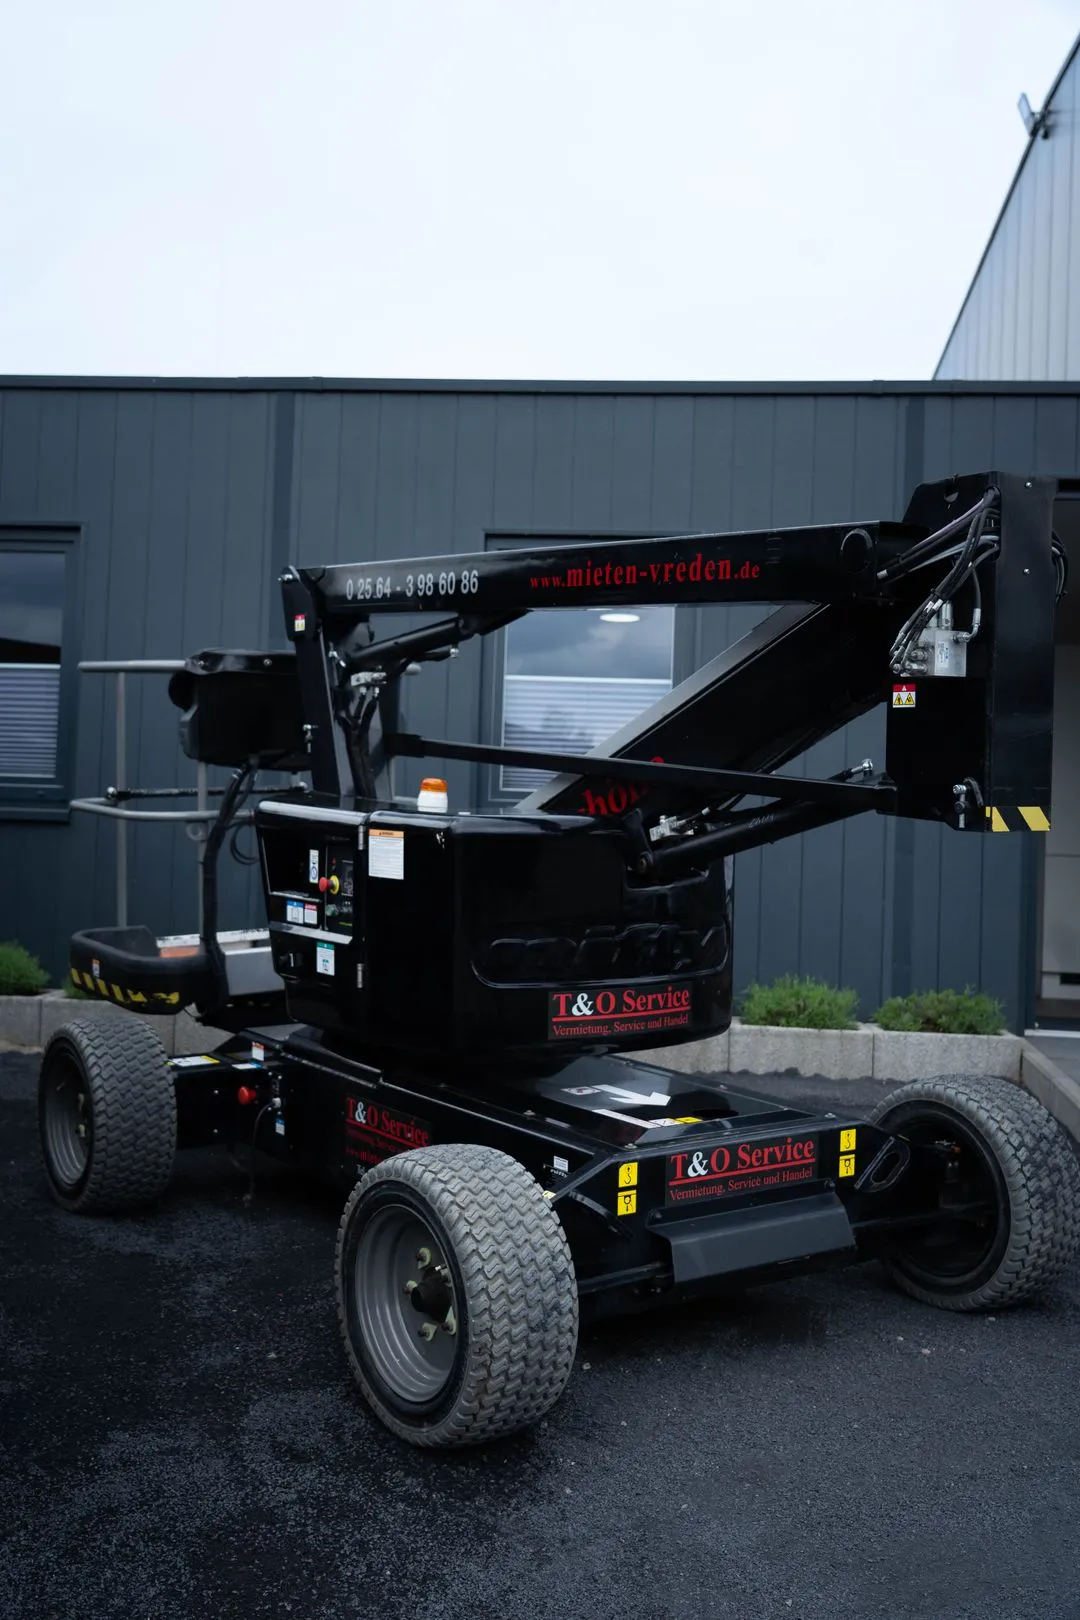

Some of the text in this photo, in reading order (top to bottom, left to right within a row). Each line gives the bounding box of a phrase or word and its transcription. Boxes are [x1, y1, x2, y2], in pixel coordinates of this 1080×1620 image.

[405, 574, 414, 598] 3
[417, 573, 434, 597] 98
[438, 571, 456, 596] 60
[460, 569, 479, 594] 86
[529, 552, 760, 589] www.mieten-vreden.de
[552, 985, 691, 1017] T&O Service
[552, 1013, 689, 1037] Vermietung, Service und Handel
[345, 1096, 379, 1128] T&O
[381, 1107, 430, 1146] Service
[670, 1137, 815, 1180] T&O Service
[669, 1166, 813, 1201] Vermietung, Service und Handel
